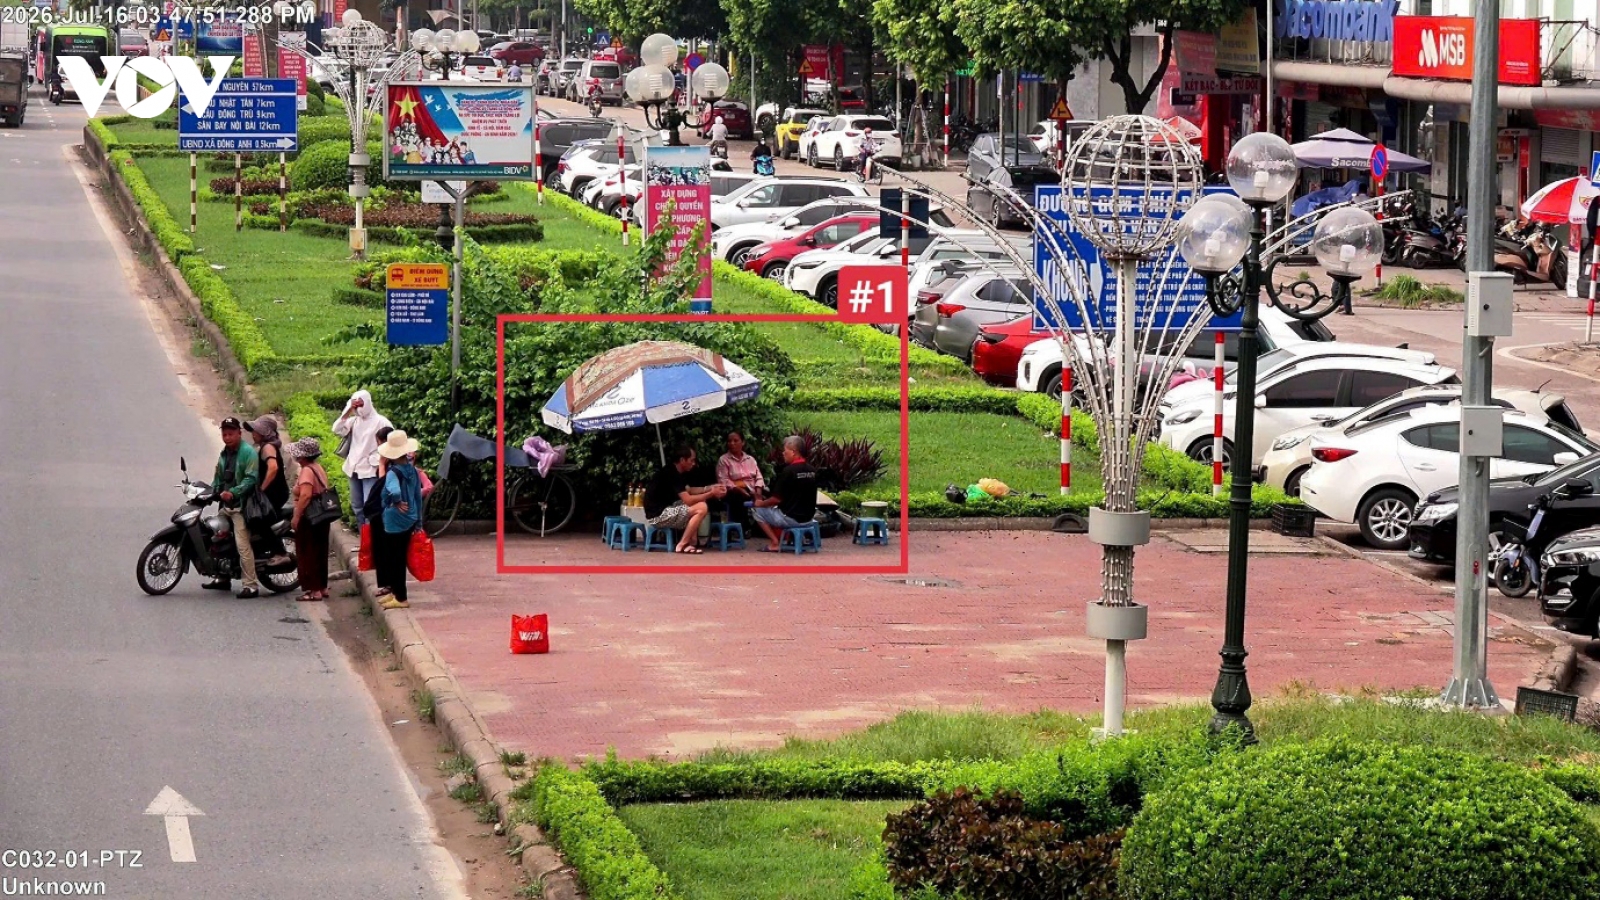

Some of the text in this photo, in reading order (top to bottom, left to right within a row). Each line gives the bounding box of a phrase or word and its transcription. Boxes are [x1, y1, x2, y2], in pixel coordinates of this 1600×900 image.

[1273, 0, 1396, 42] Sacombank
[1439, 33, 1465, 65] MSB
[503, 166, 522, 175] BIDV
[661, 188, 697, 198] XÂY DỰNG
